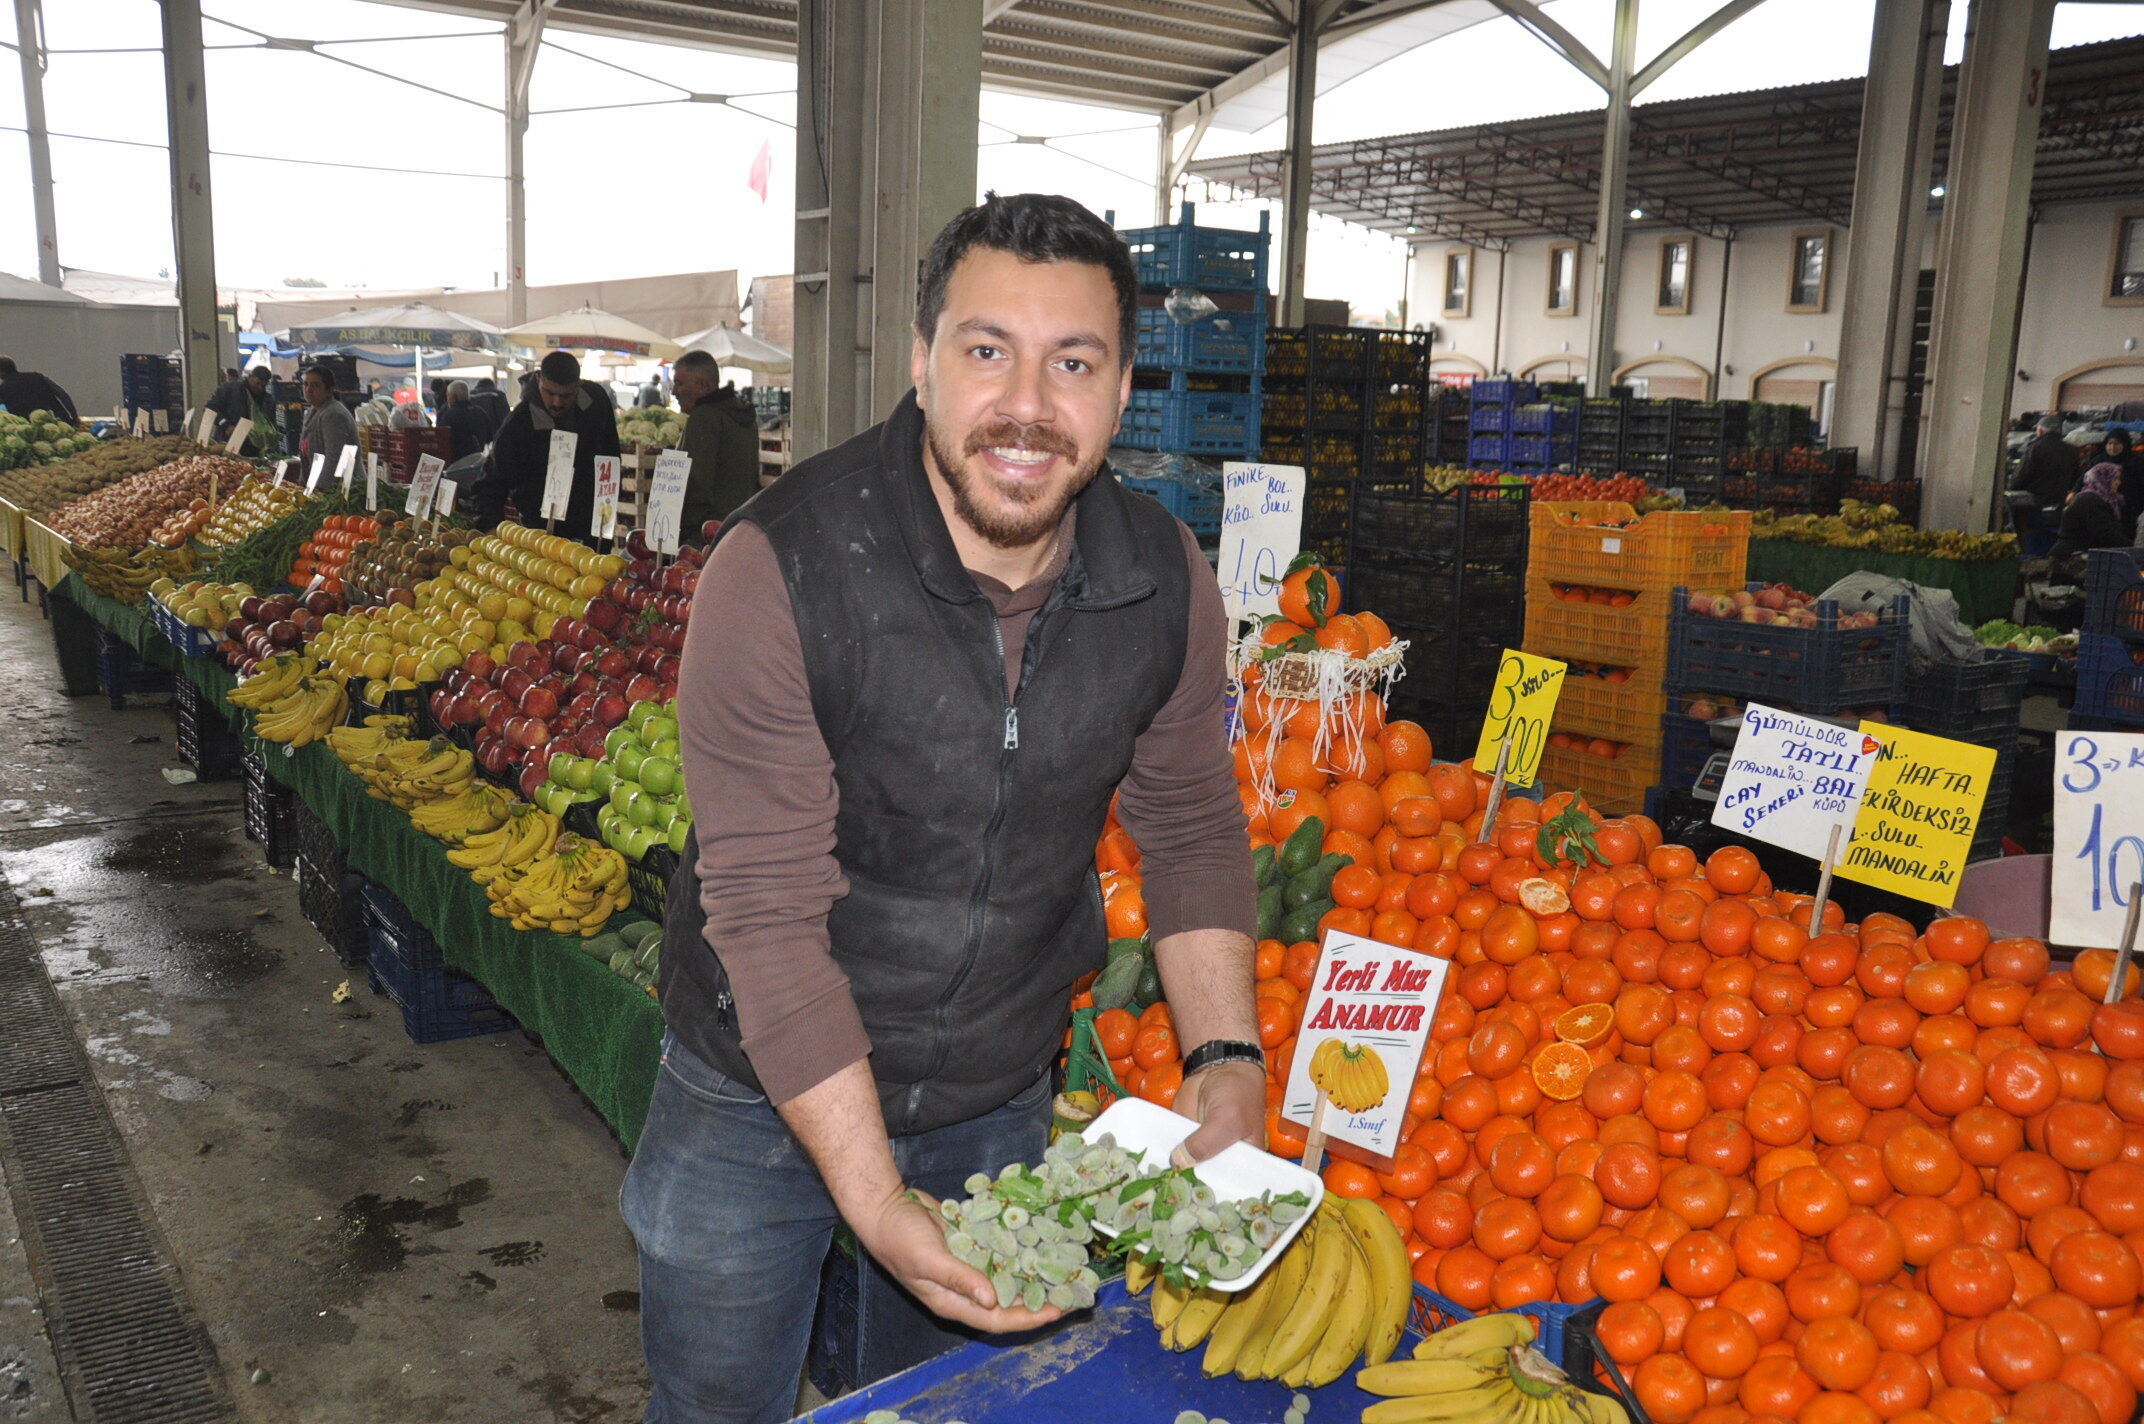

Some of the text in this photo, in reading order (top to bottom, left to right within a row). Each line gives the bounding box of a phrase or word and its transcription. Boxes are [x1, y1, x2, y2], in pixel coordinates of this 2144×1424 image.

[599, 460, 612, 482] 24
[652, 507, 670, 543] 60
[1489, 656, 1525, 721] 3
[1485, 715, 1543, 775] 100
[1745, 709, 1848, 748] GÜMÜLDÜR
[2062, 736, 2102, 793] 3
[1812, 777, 1857, 800] BAL
[1742, 785, 1846, 833] ŞEKERİ KÜPÜ
[1860, 788, 1974, 837] EKİRDEKSİZ
[1847, 846, 1954, 886] MANDALİN
[1322, 959, 1432, 993] Yerli Muz
[1307, 996, 1426, 1032] ANAMUR
